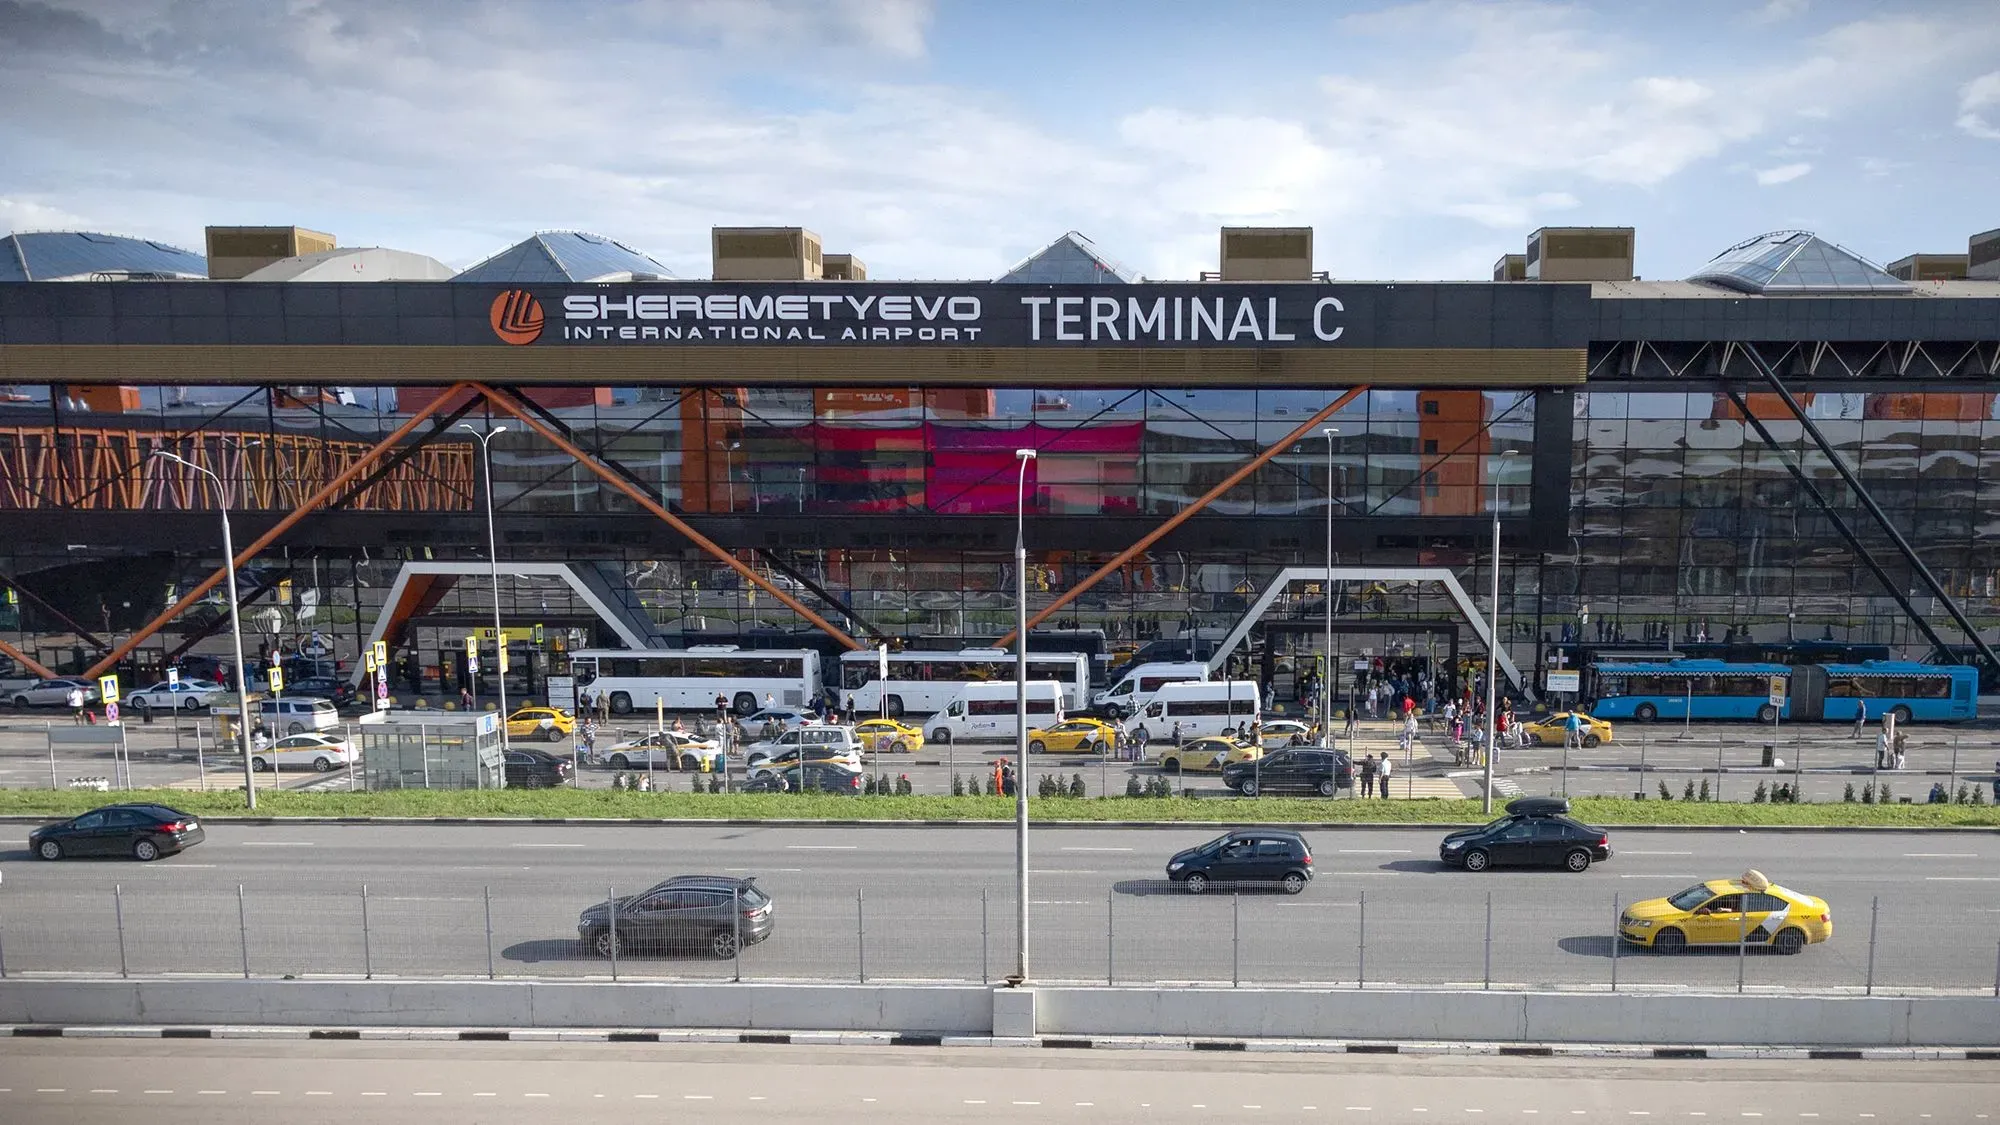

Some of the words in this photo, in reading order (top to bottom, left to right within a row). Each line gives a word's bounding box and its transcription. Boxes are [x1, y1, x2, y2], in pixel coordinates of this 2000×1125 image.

[563, 294, 981, 321] SHEREMETYEVO
[1021, 297, 1296, 341] TERMINAL
[1313, 297, 1345, 341] C
[564, 326, 825, 340] INTERNATIONAL
[841, 326, 982, 341] AIRPORT
[1771, 697, 1784, 705] TAXI
